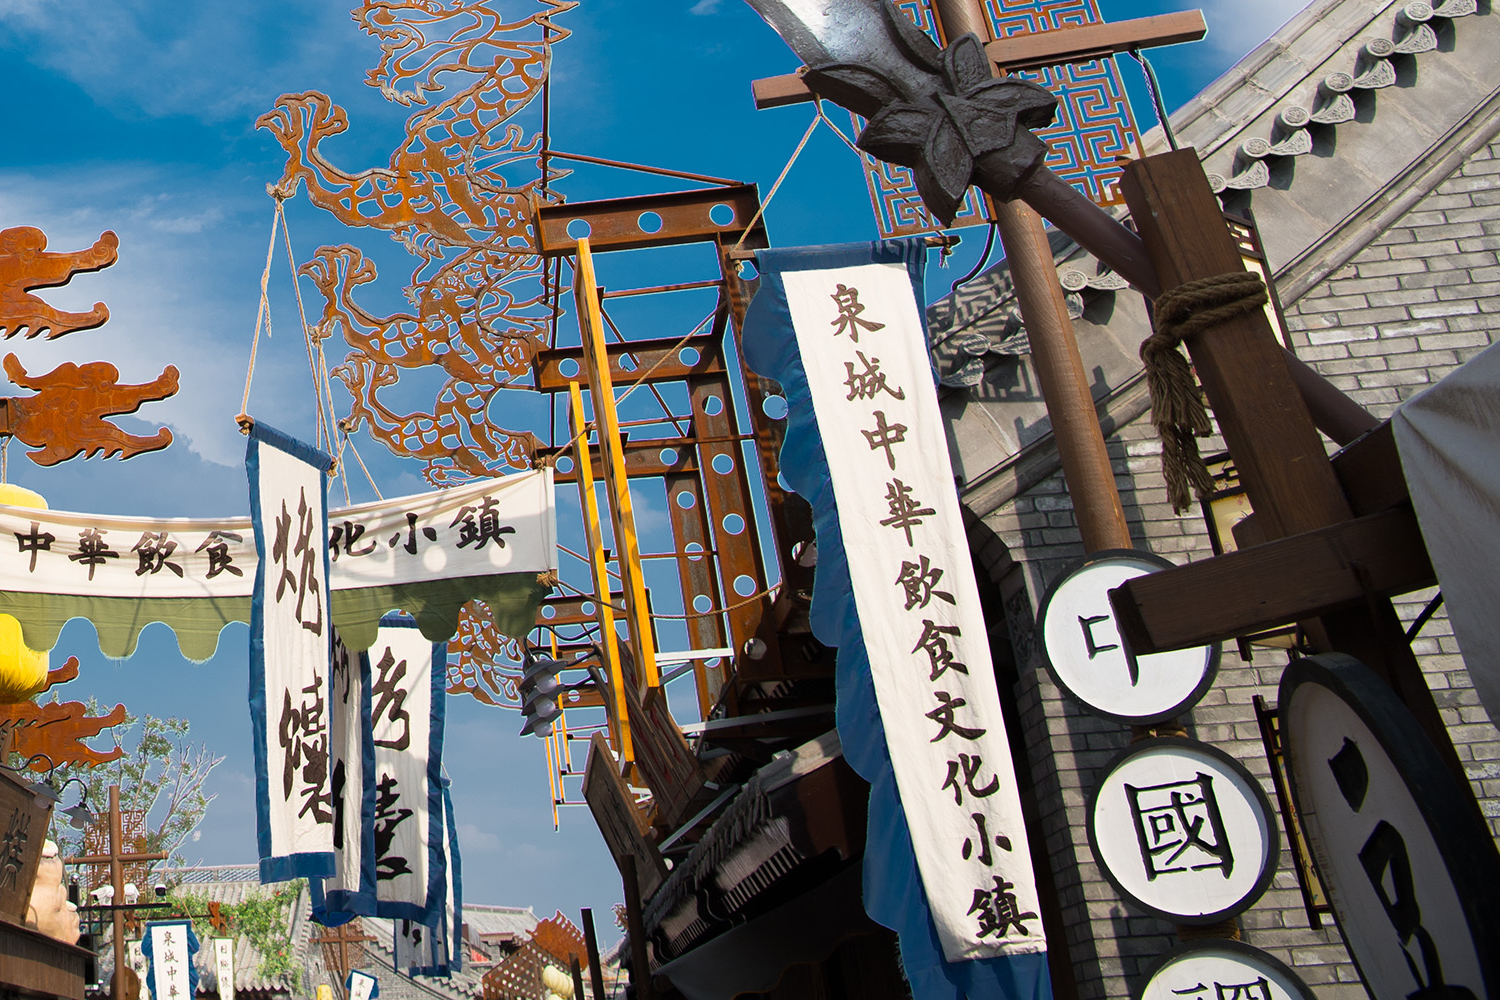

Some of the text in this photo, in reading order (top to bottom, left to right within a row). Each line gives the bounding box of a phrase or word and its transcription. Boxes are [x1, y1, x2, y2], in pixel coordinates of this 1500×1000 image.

[830, 283, 1038, 940] 泉城中華飲食文化小鎮
[1124, 771, 1234, 882] 國
